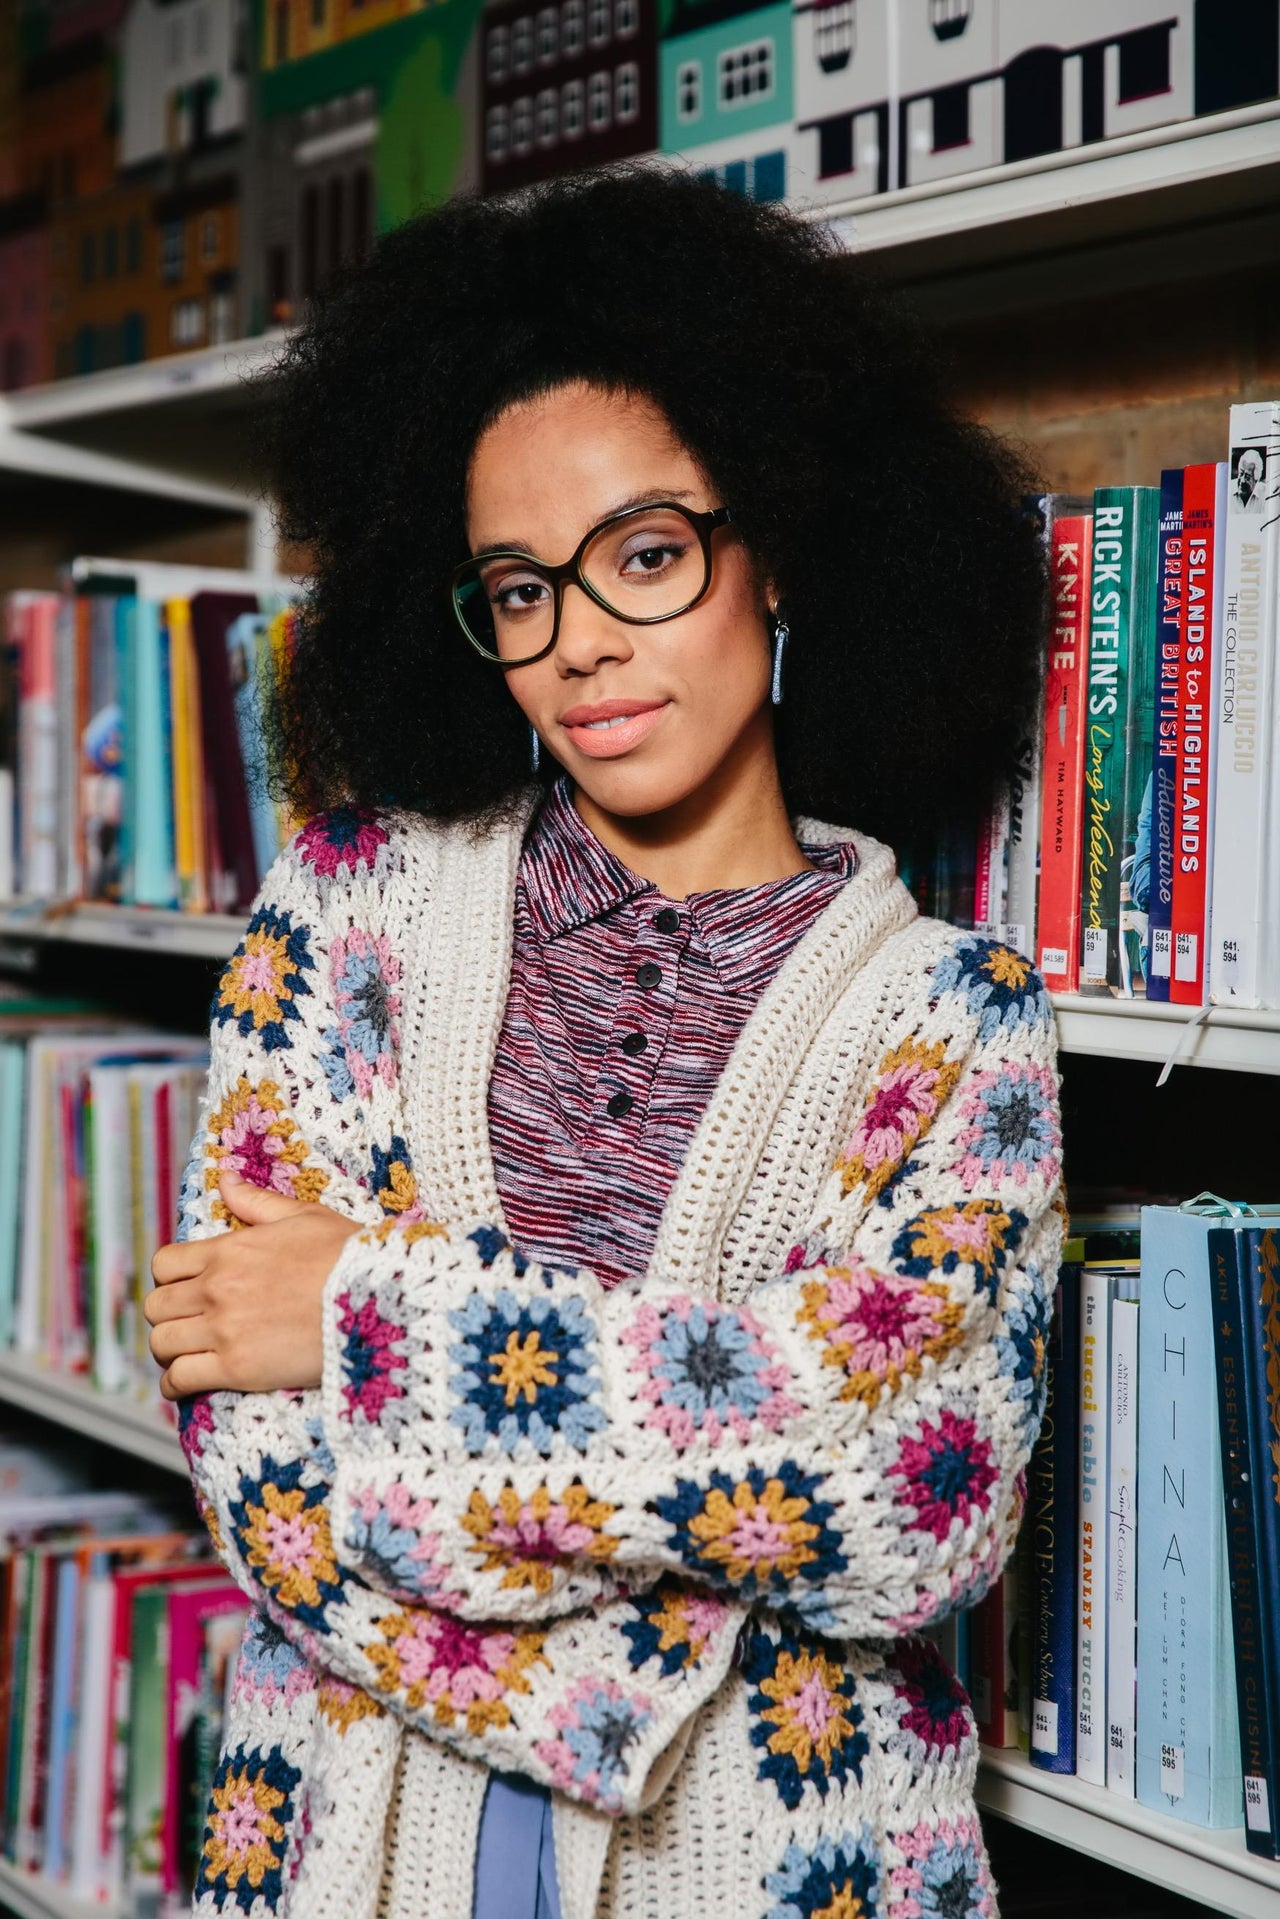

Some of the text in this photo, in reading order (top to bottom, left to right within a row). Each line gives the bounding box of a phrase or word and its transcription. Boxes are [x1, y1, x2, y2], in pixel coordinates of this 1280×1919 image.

[1164, 510, 1183, 521] JAME
[1187, 509, 1209, 519] JAMES
[1160, 521, 1184, 531] MARTI
[1053, 542, 1078, 670] KNIFE
[1089, 506, 1123, 715] RICK STEIN'S
[1223, 592, 1238, 725] THE COLLECTION
[1233, 541, 1261, 774] ANTONIO CARLUCCIO
[1181, 538, 1207, 873] ISLANDS to HIGHLANDS
[1157, 537, 1183, 905] GREAT BRITISH Adventure
[1085, 724, 1111, 796] Long
[1055, 761, 1065, 853] TIM HAYWARD
[980, 880, 989, 920] MILES
[1086, 930, 1101, 941] 641.
[1155, 931, 1171, 942] 641.
[1177, 933, 1192, 944] 641.
[1086, 941, 1095, 951] 59
[1155, 942, 1169, 953] 594
[1177, 944, 1190, 955] 594
[1223, 940, 1240, 952] 641.
[1223, 951, 1237, 962] 594
[1216, 1253, 1228, 1301] AKIN
[1116, 1353, 1124, 1425] CARLUCCIO'S
[1083, 1295, 1098, 1503] the tucci table
[1163, 1268, 1186, 1577] CHINA
[1223, 1355, 1244, 1493] ESSENTIAL
[1109, 1485, 1133, 1603] Simple Cooking
[1231, 1499, 1256, 1661] TURKISH
[1040, 1578, 1054, 1644] Cookery
[1081, 1520, 1093, 1711] STANLEY TUCCI
[1036, 1713, 1052, 1724] 641.
[1036, 1723, 1048, 1732] 594
[1079, 1723, 1092, 1736] 594
[1110, 1725, 1125, 1738] 641.
[1110, 1736, 1123, 1749] 594
[1161, 1744, 1178, 1759] 641.
[1161, 1756, 1176, 1770] 595
[1246, 1779, 1262, 1792] 641.
[1246, 1790, 1261, 1804] 595
